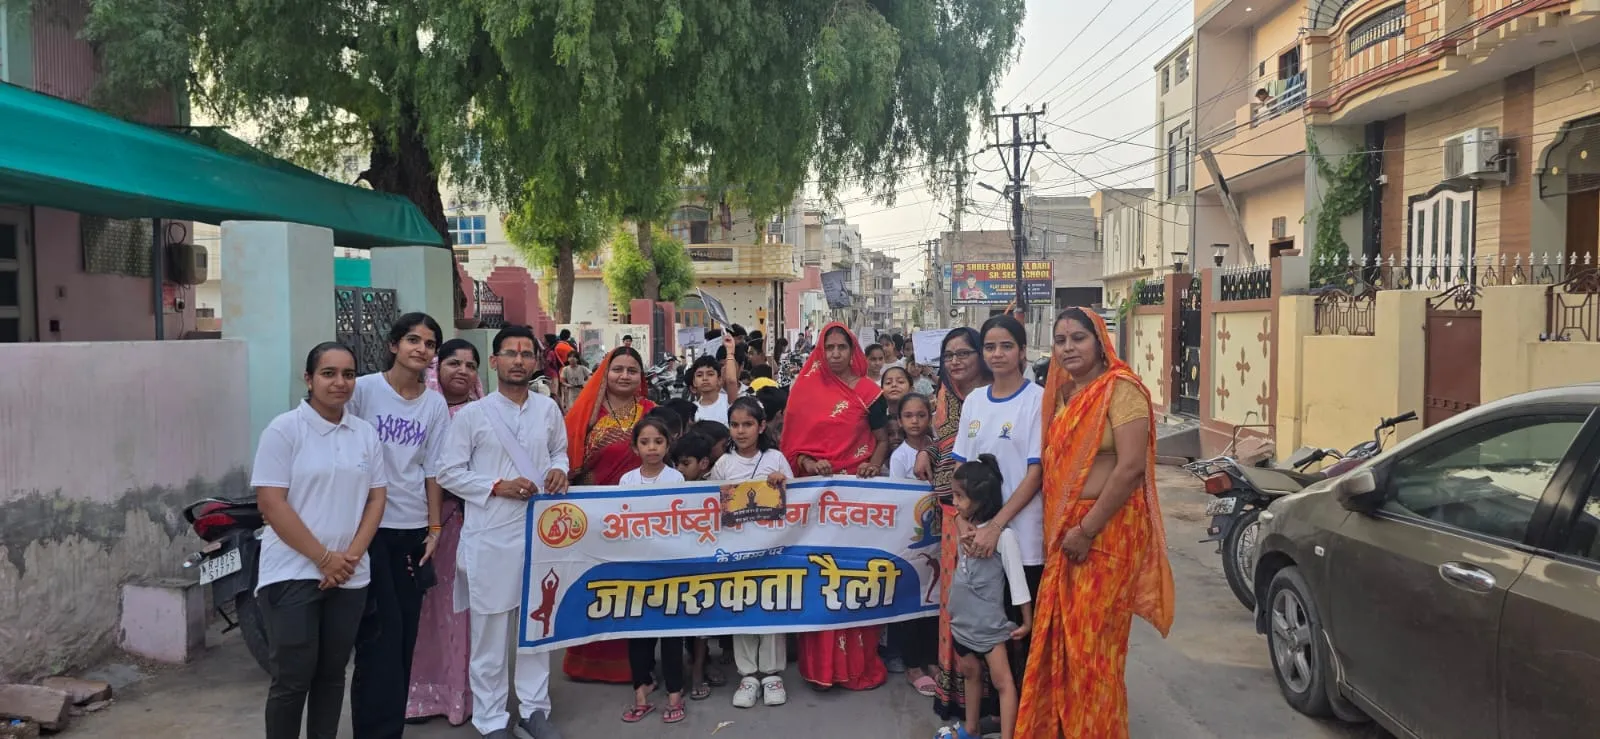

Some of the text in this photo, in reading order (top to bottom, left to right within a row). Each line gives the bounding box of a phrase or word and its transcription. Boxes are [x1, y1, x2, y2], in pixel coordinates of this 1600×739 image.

[966, 263, 989, 271] SHREE
[990, 263, 1015, 271] SURAJ
[988, 271, 1001, 279] SR.
[602, 497, 742, 544] अंतर्राष्ट्री
[818, 490, 898, 528] दिवस
[715, 548, 730, 563] के
[808, 554, 902, 615] रैली
